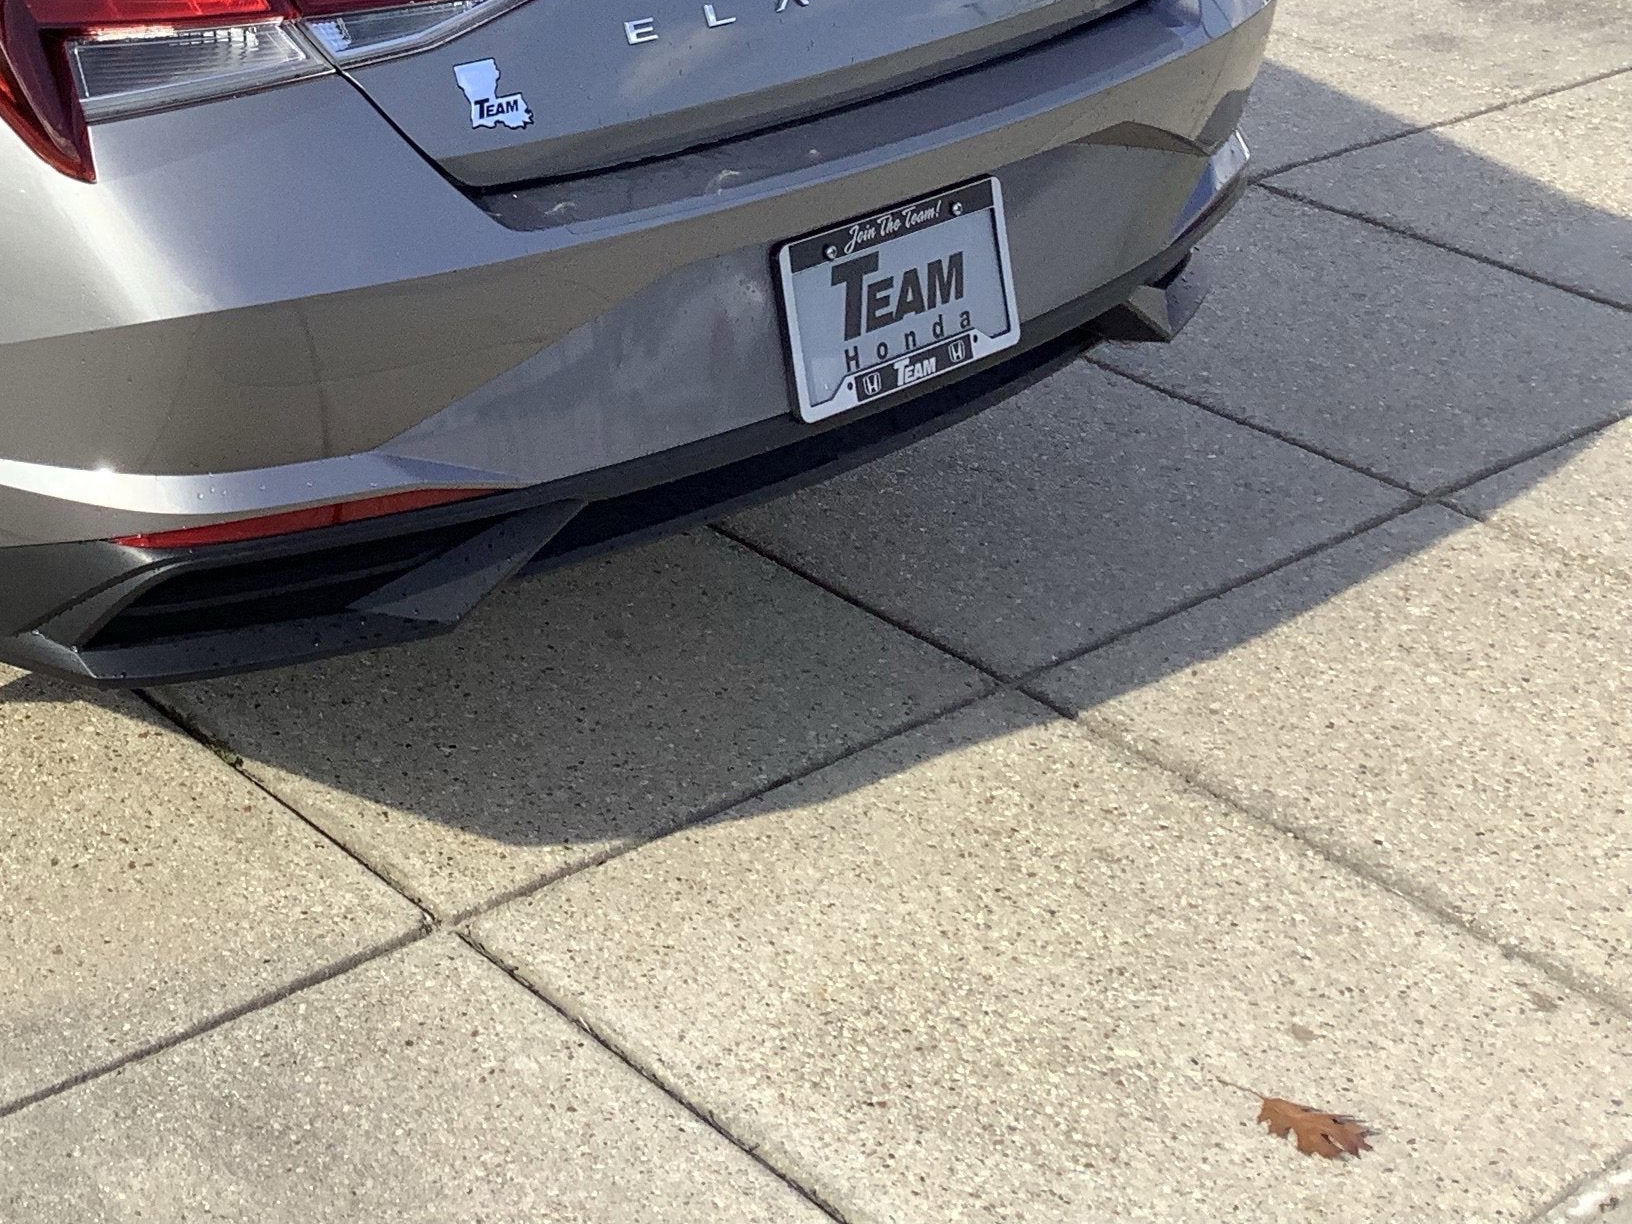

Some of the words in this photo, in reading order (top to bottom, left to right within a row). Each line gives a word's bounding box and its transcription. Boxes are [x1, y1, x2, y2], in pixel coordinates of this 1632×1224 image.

[474, 97, 519, 119] TEAM
[844, 224, 876, 254] Join
[877, 213, 901, 237] The
[902, 200, 942, 227] Team!
[830, 250, 965, 342] TEAM
[844, 310, 971, 373] Honda
[893, 357, 937, 387] TEAM
